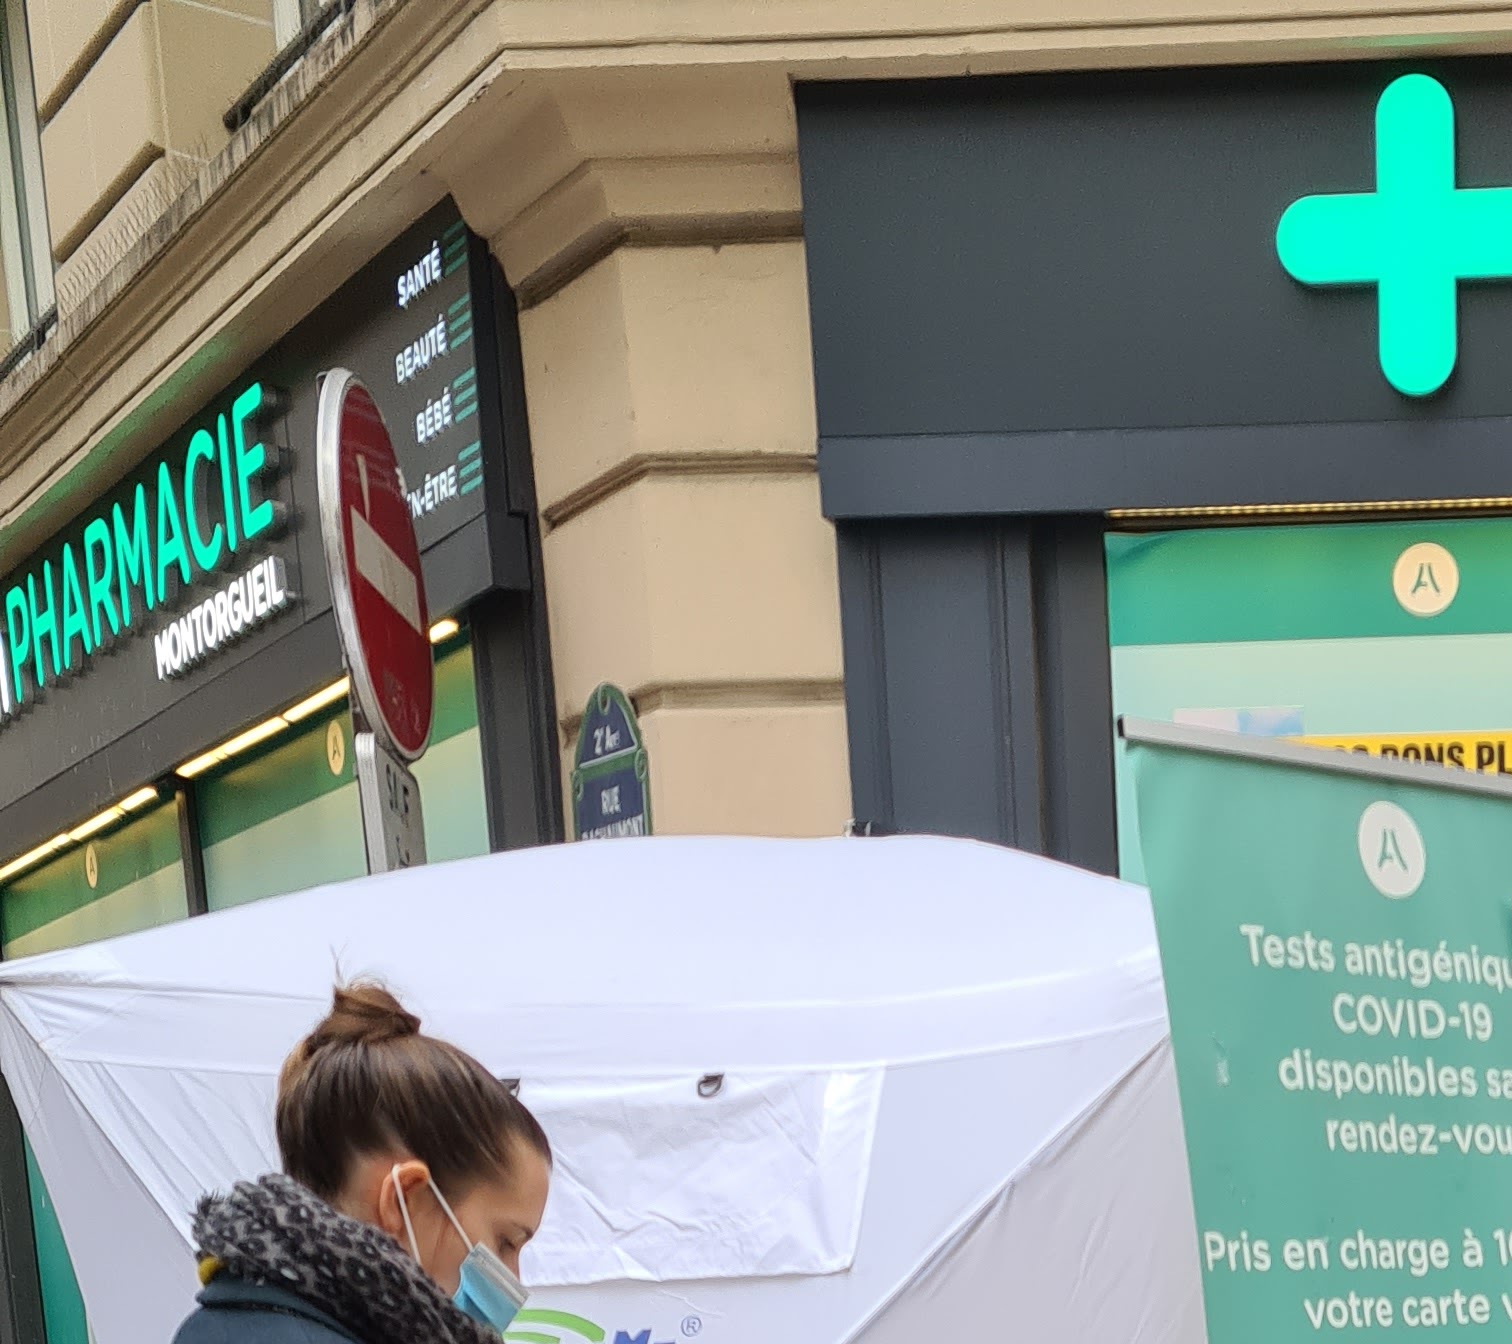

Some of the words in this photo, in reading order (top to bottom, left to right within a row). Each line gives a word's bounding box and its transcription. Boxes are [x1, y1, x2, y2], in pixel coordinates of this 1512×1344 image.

[397, 240, 441, 309] SANTÉ
[396, 313, 447, 384] BEAUTÉ
[416, 386, 453, 444] BÉBÉ
[397, 464, 458, 520] N-ÊTRE
[7, 381, 275, 704] PHARMACIE
[154, 556, 286, 682] MONTORGUEIL
[1239, 924, 1335, 973] Tests
[1333, 992, 1493, 1042] COVID-19
[1278, 1048, 1478, 1100] disponibles
[1204, 1230, 1271, 1272] Pris
[1283, 1239, 1329, 1272] en
[1340, 1233, 1449, 1278] charge
[1462, 1229, 1484, 1268] à
[1304, 1290, 1393, 1330] votre
[1401, 1288, 1490, 1327] carte
